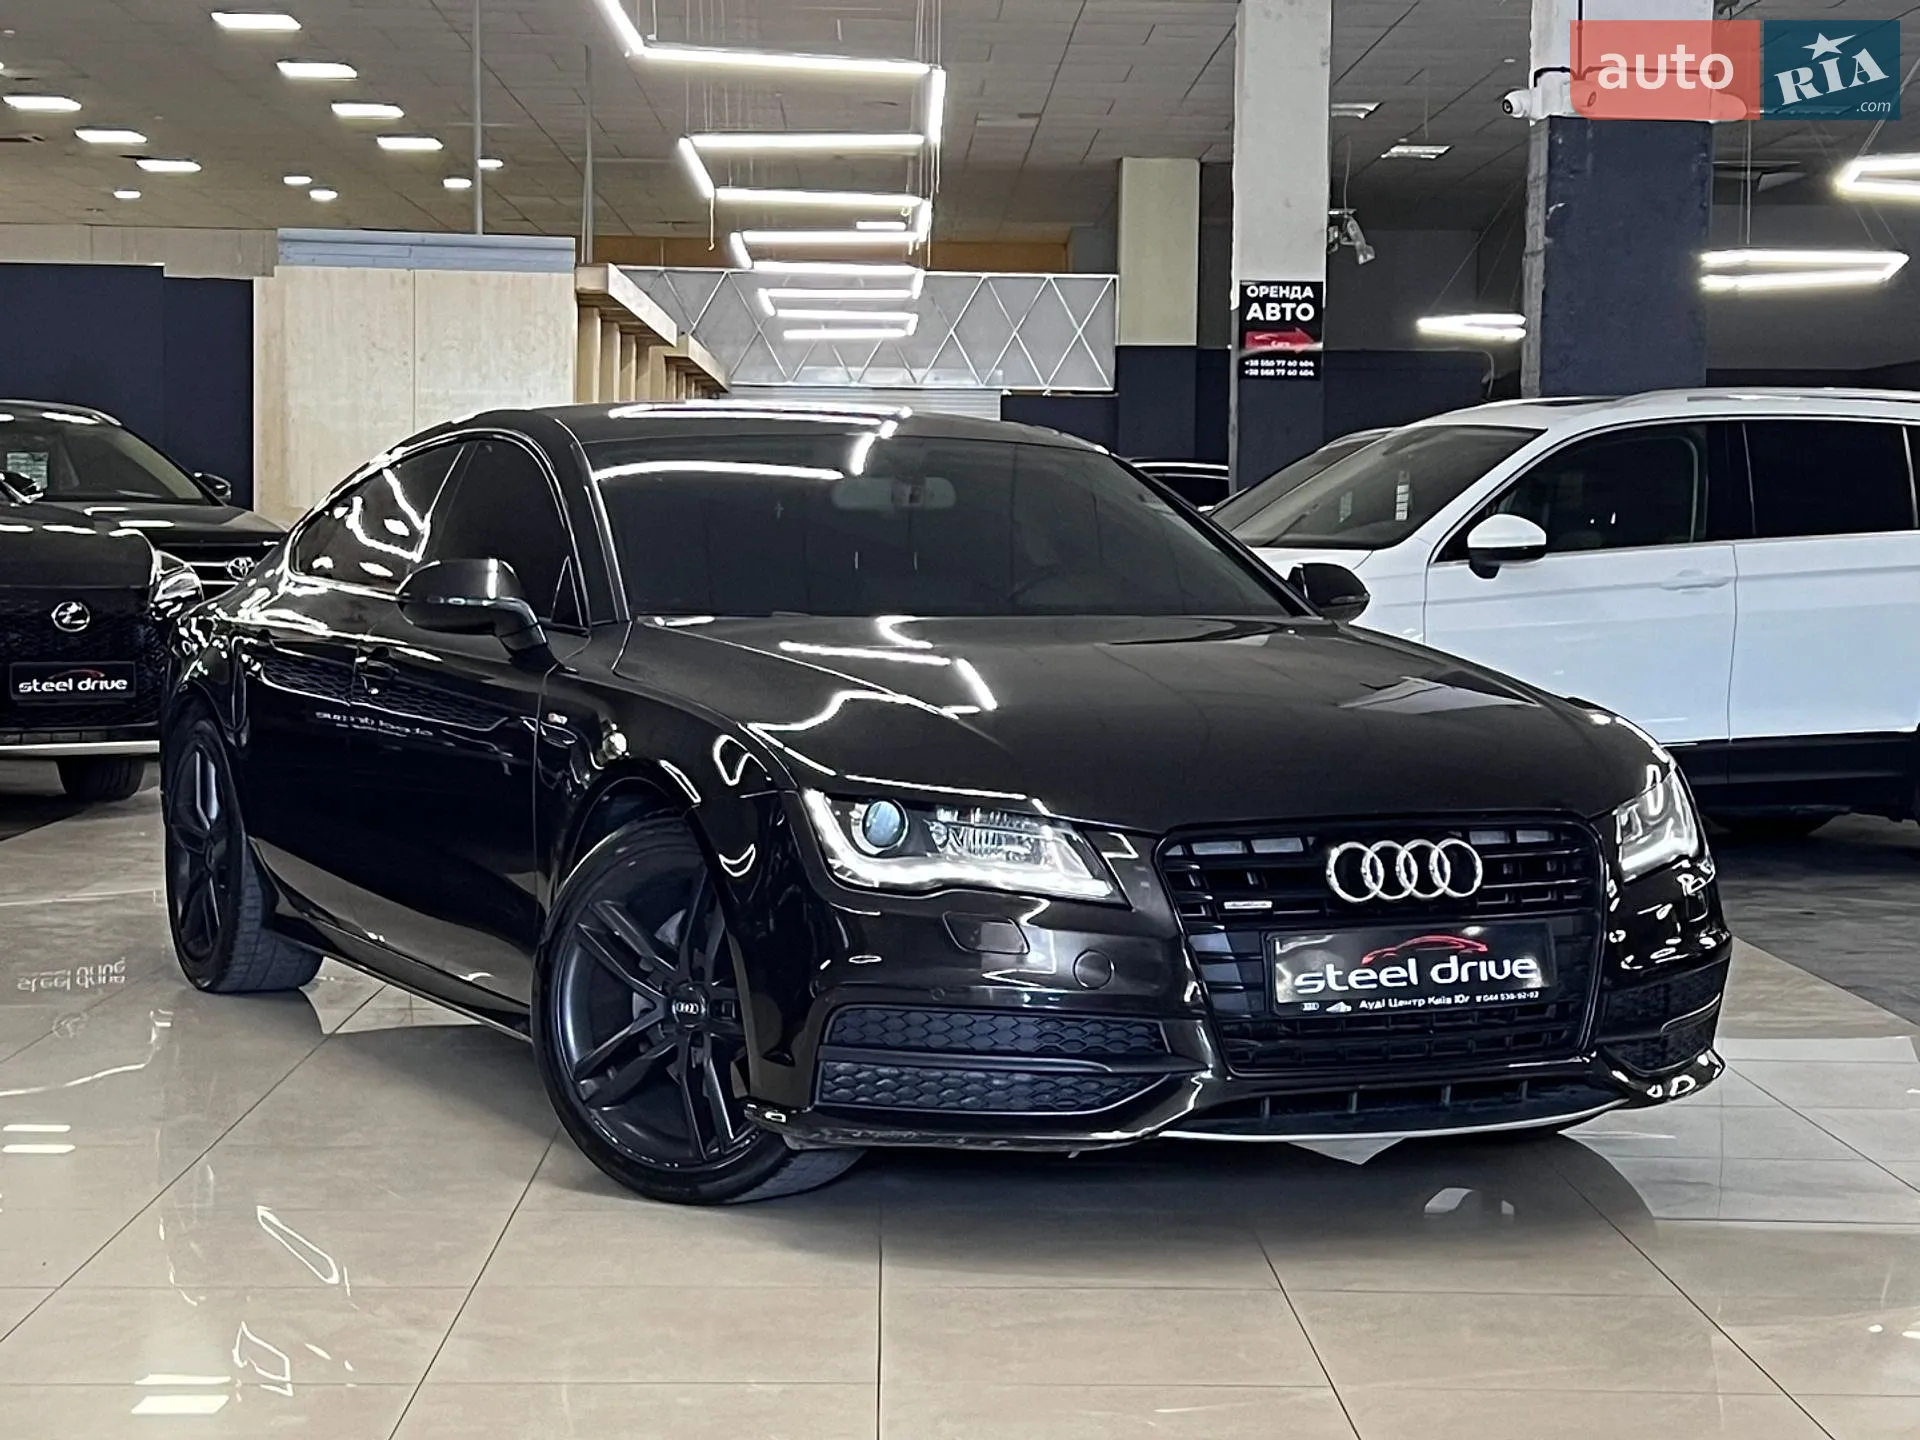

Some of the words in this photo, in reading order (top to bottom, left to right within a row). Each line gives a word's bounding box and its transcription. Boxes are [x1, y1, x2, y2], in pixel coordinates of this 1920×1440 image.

[1246, 285, 1314, 300] ОРЕНДА
[1246, 303, 1315, 321] АВТО
[19, 678, 73, 693] steel
[77, 677, 128, 691] drive
[1294, 958, 1419, 994] steel
[1430, 955, 1538, 984] drive
